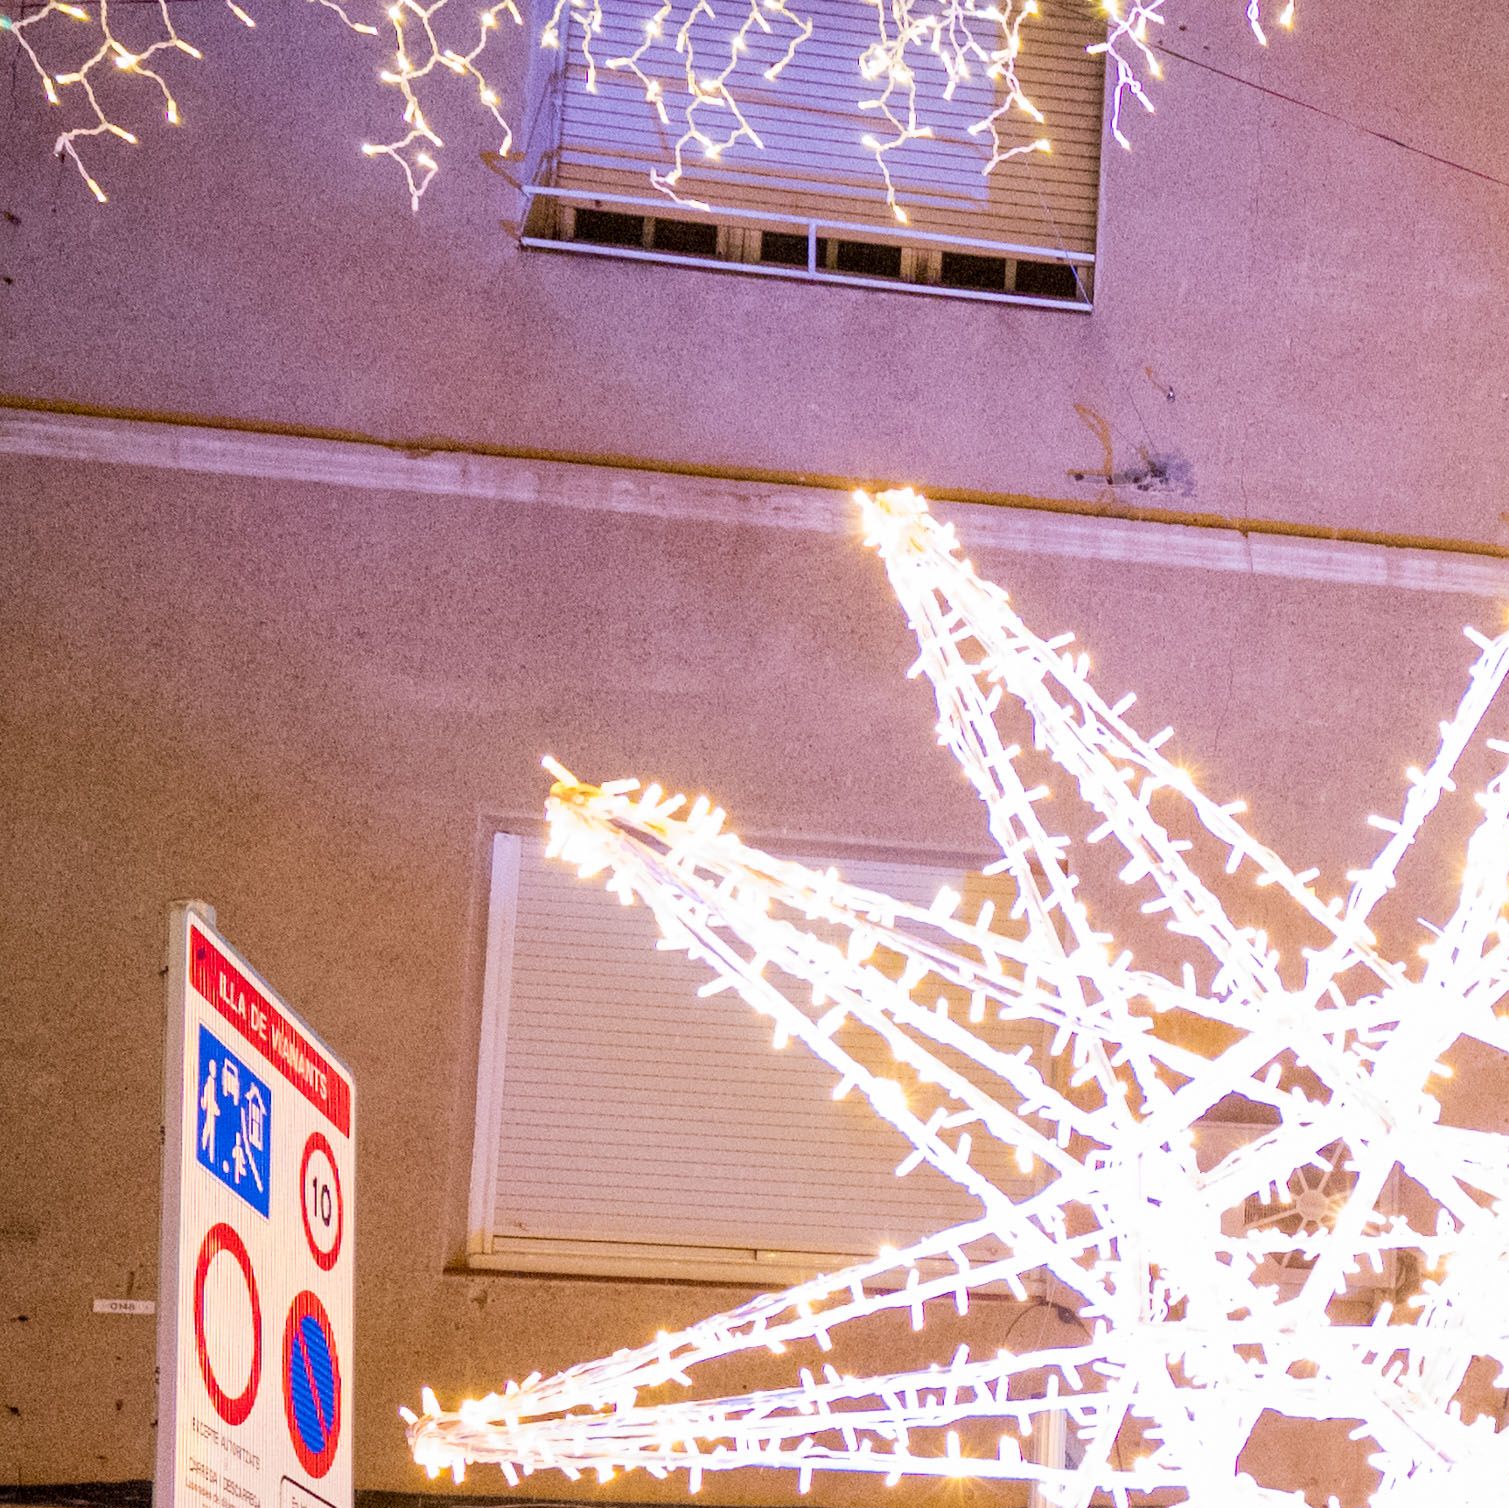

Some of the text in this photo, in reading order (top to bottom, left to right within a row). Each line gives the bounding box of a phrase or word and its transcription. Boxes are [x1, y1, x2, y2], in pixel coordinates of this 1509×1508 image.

[219, 970, 328, 1101] ILLA DE VIANANTS
[312, 1176, 331, 1227] 10
